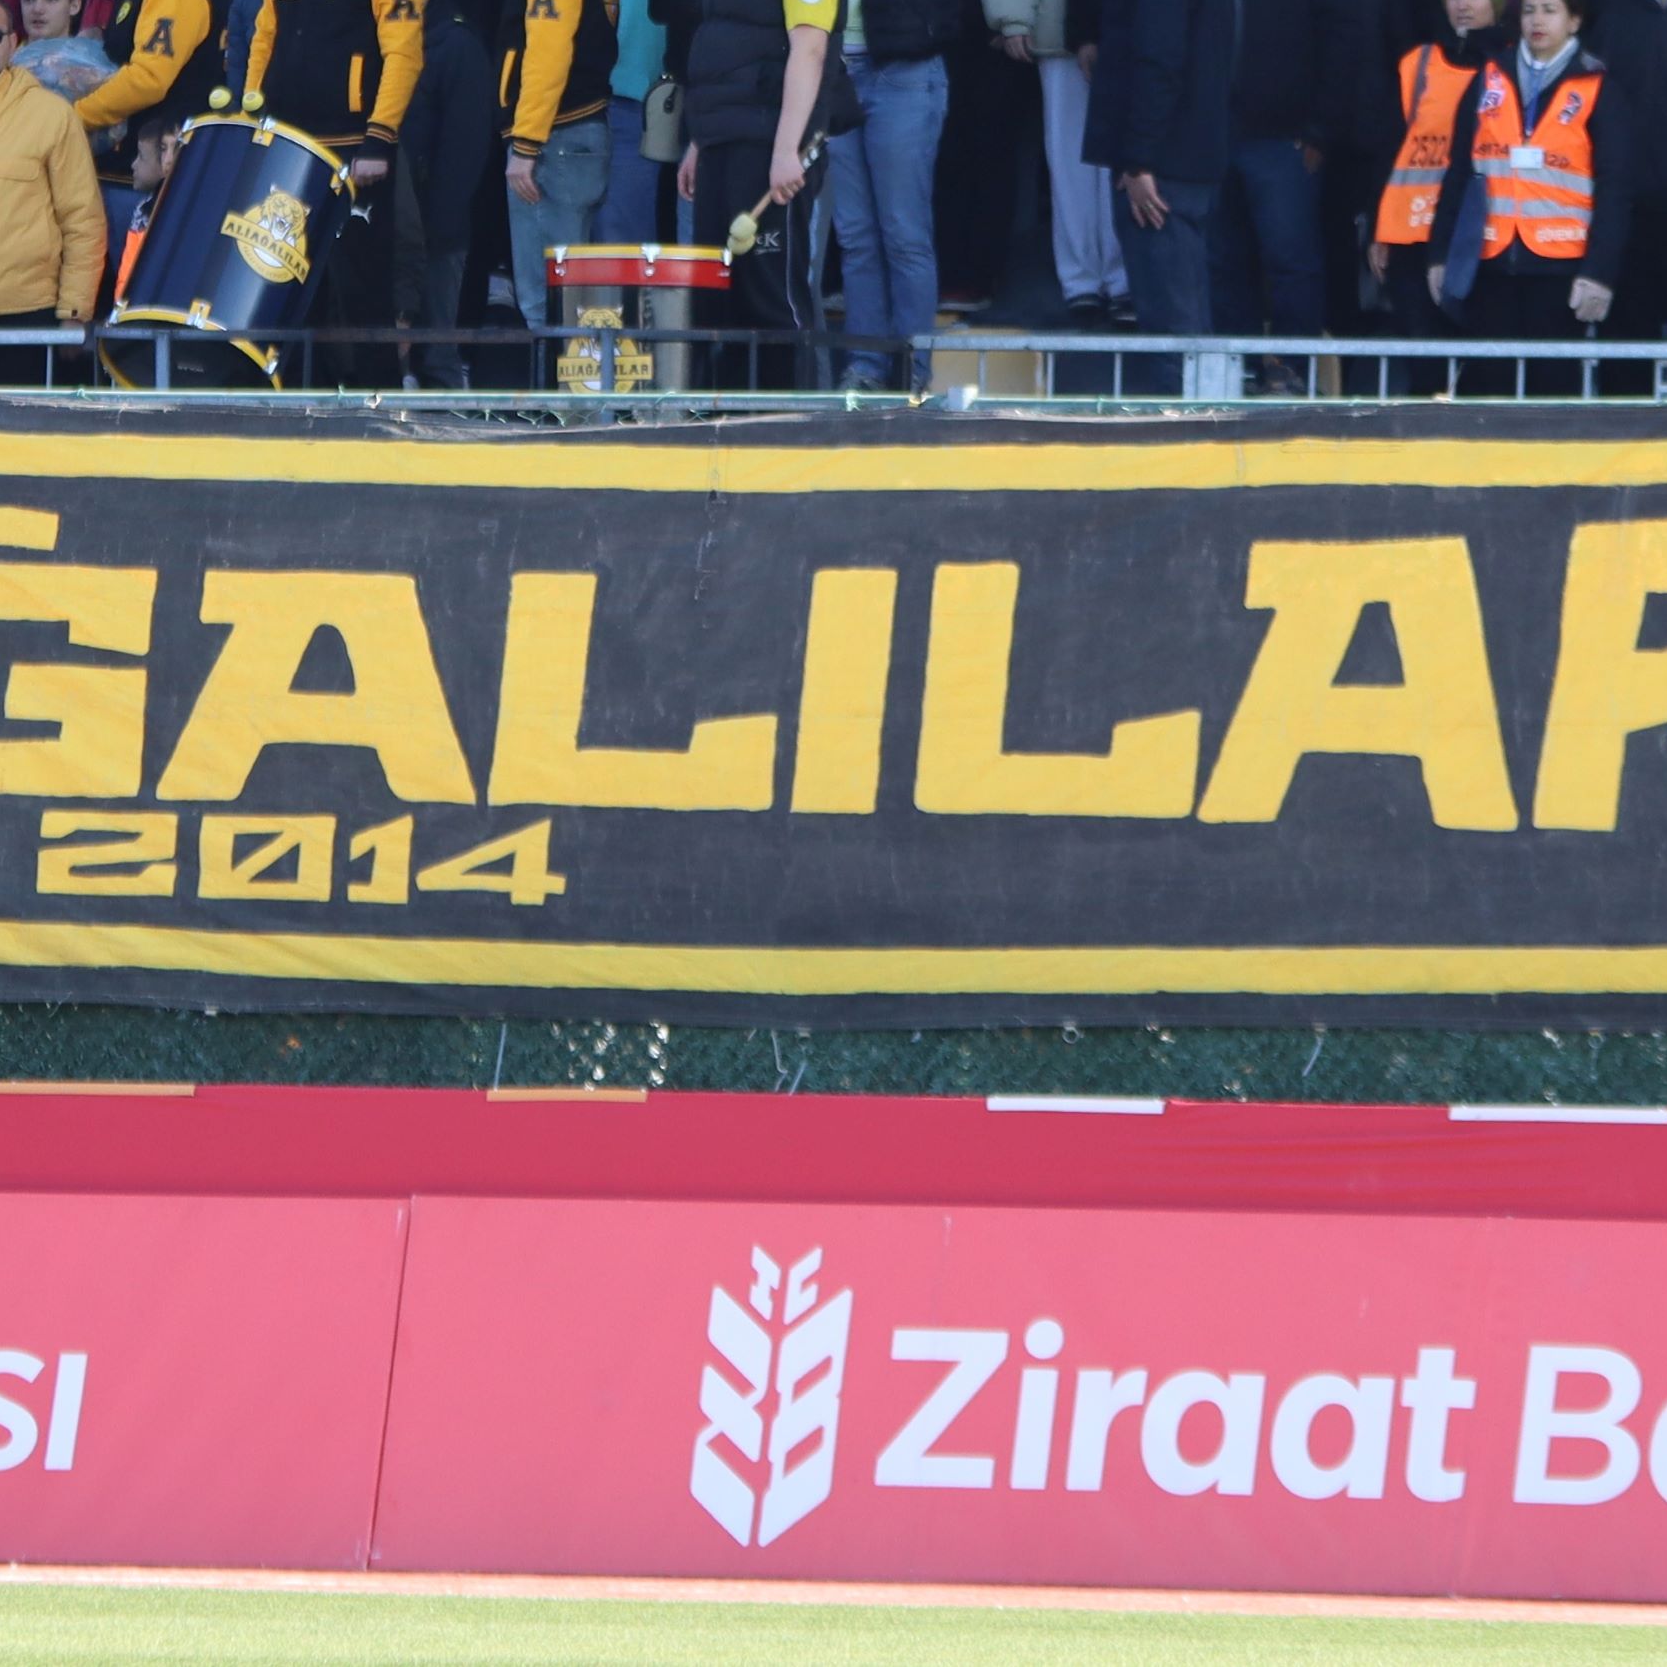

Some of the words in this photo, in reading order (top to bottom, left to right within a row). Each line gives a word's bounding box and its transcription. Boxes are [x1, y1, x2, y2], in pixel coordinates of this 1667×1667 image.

[141, 17, 176, 57] A
[36, 809, 567, 905] 2014
[873, 1316, 1478, 1504] Ziraat
